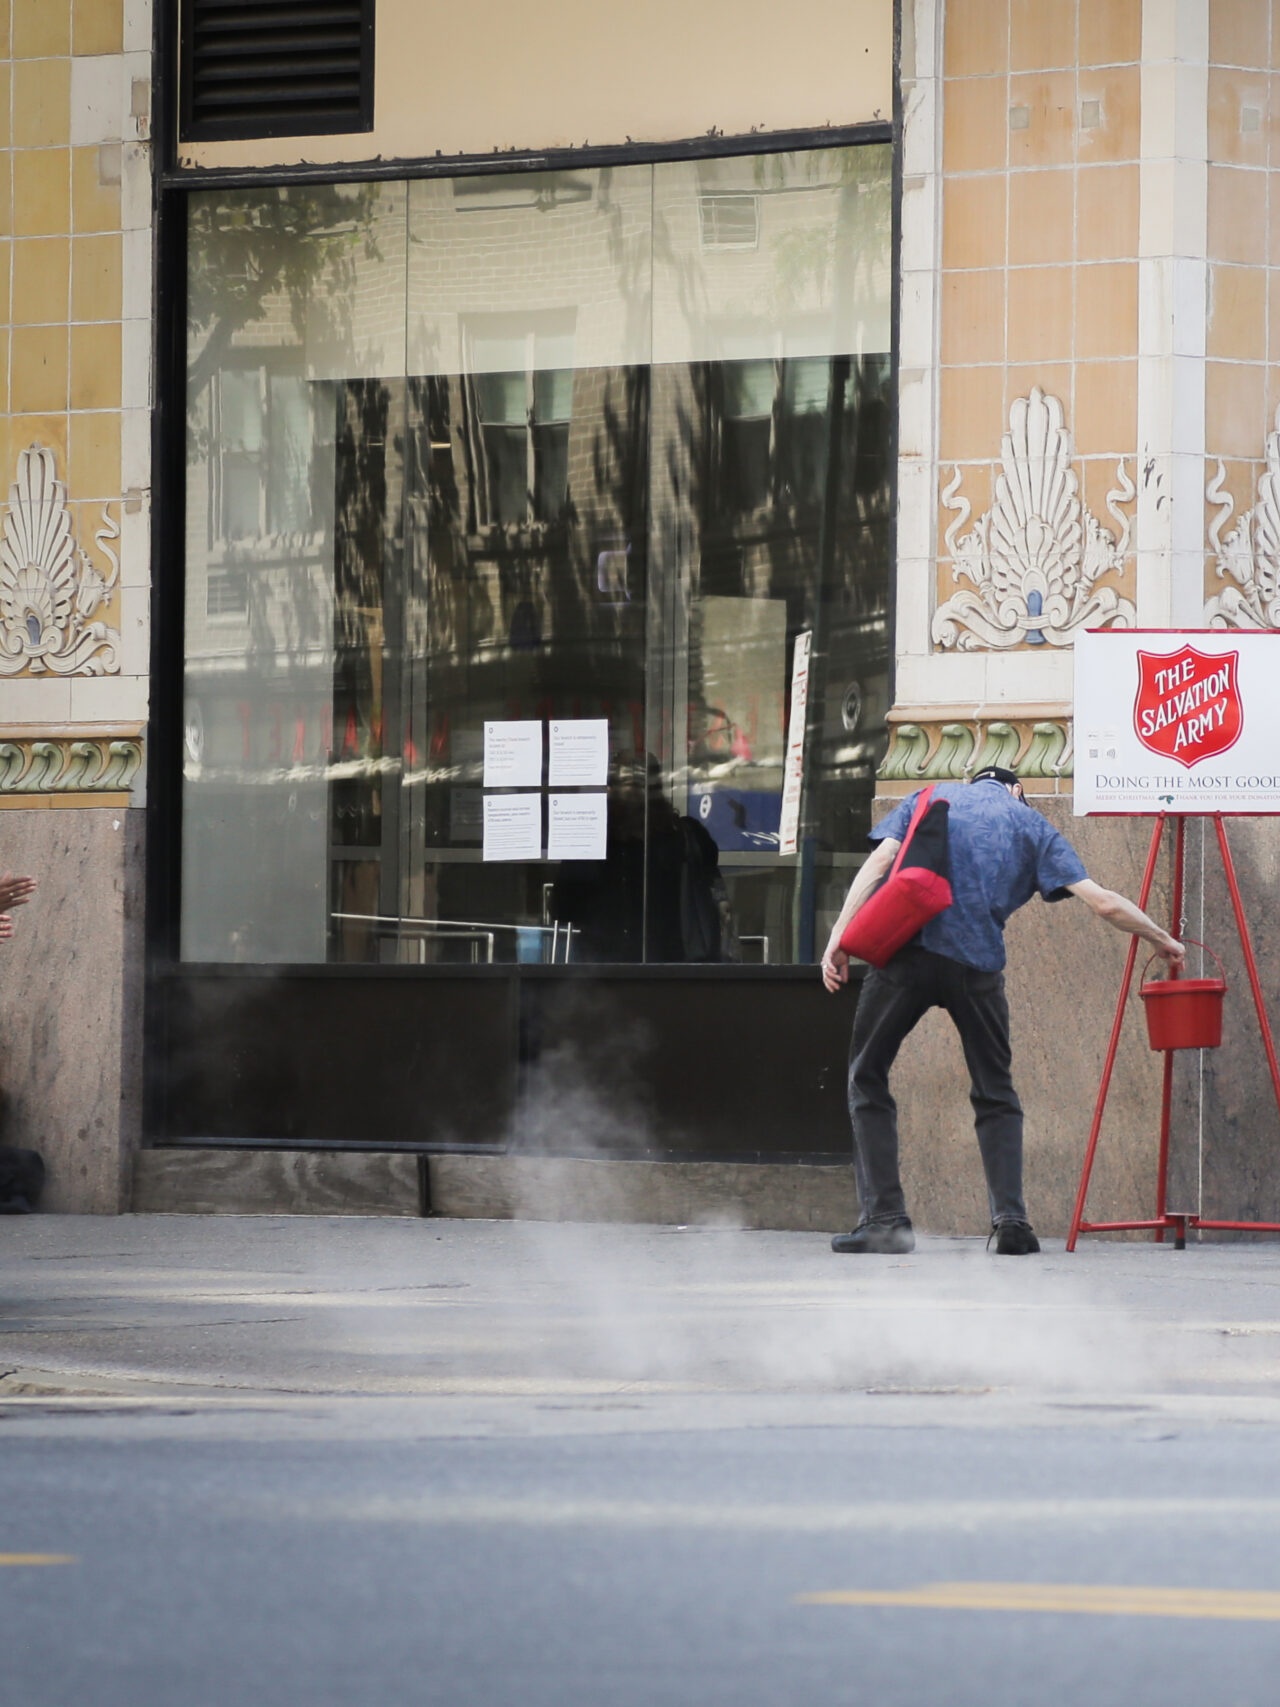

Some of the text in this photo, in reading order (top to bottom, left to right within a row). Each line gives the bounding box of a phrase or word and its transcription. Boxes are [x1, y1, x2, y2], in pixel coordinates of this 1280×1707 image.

[1154, 657, 1196, 696] THE
[1141, 662, 1230, 737] SALVATION
[1173, 698, 1228, 753] ARMY
[1095, 774, 1150, 789] DOING
[1152, 776, 1184, 788] THE
[1190, 776, 1232, 788] MOST
[1118, 793, 1155, 801] CHRISTMAS
[1176, 793, 1198, 801] THANK
